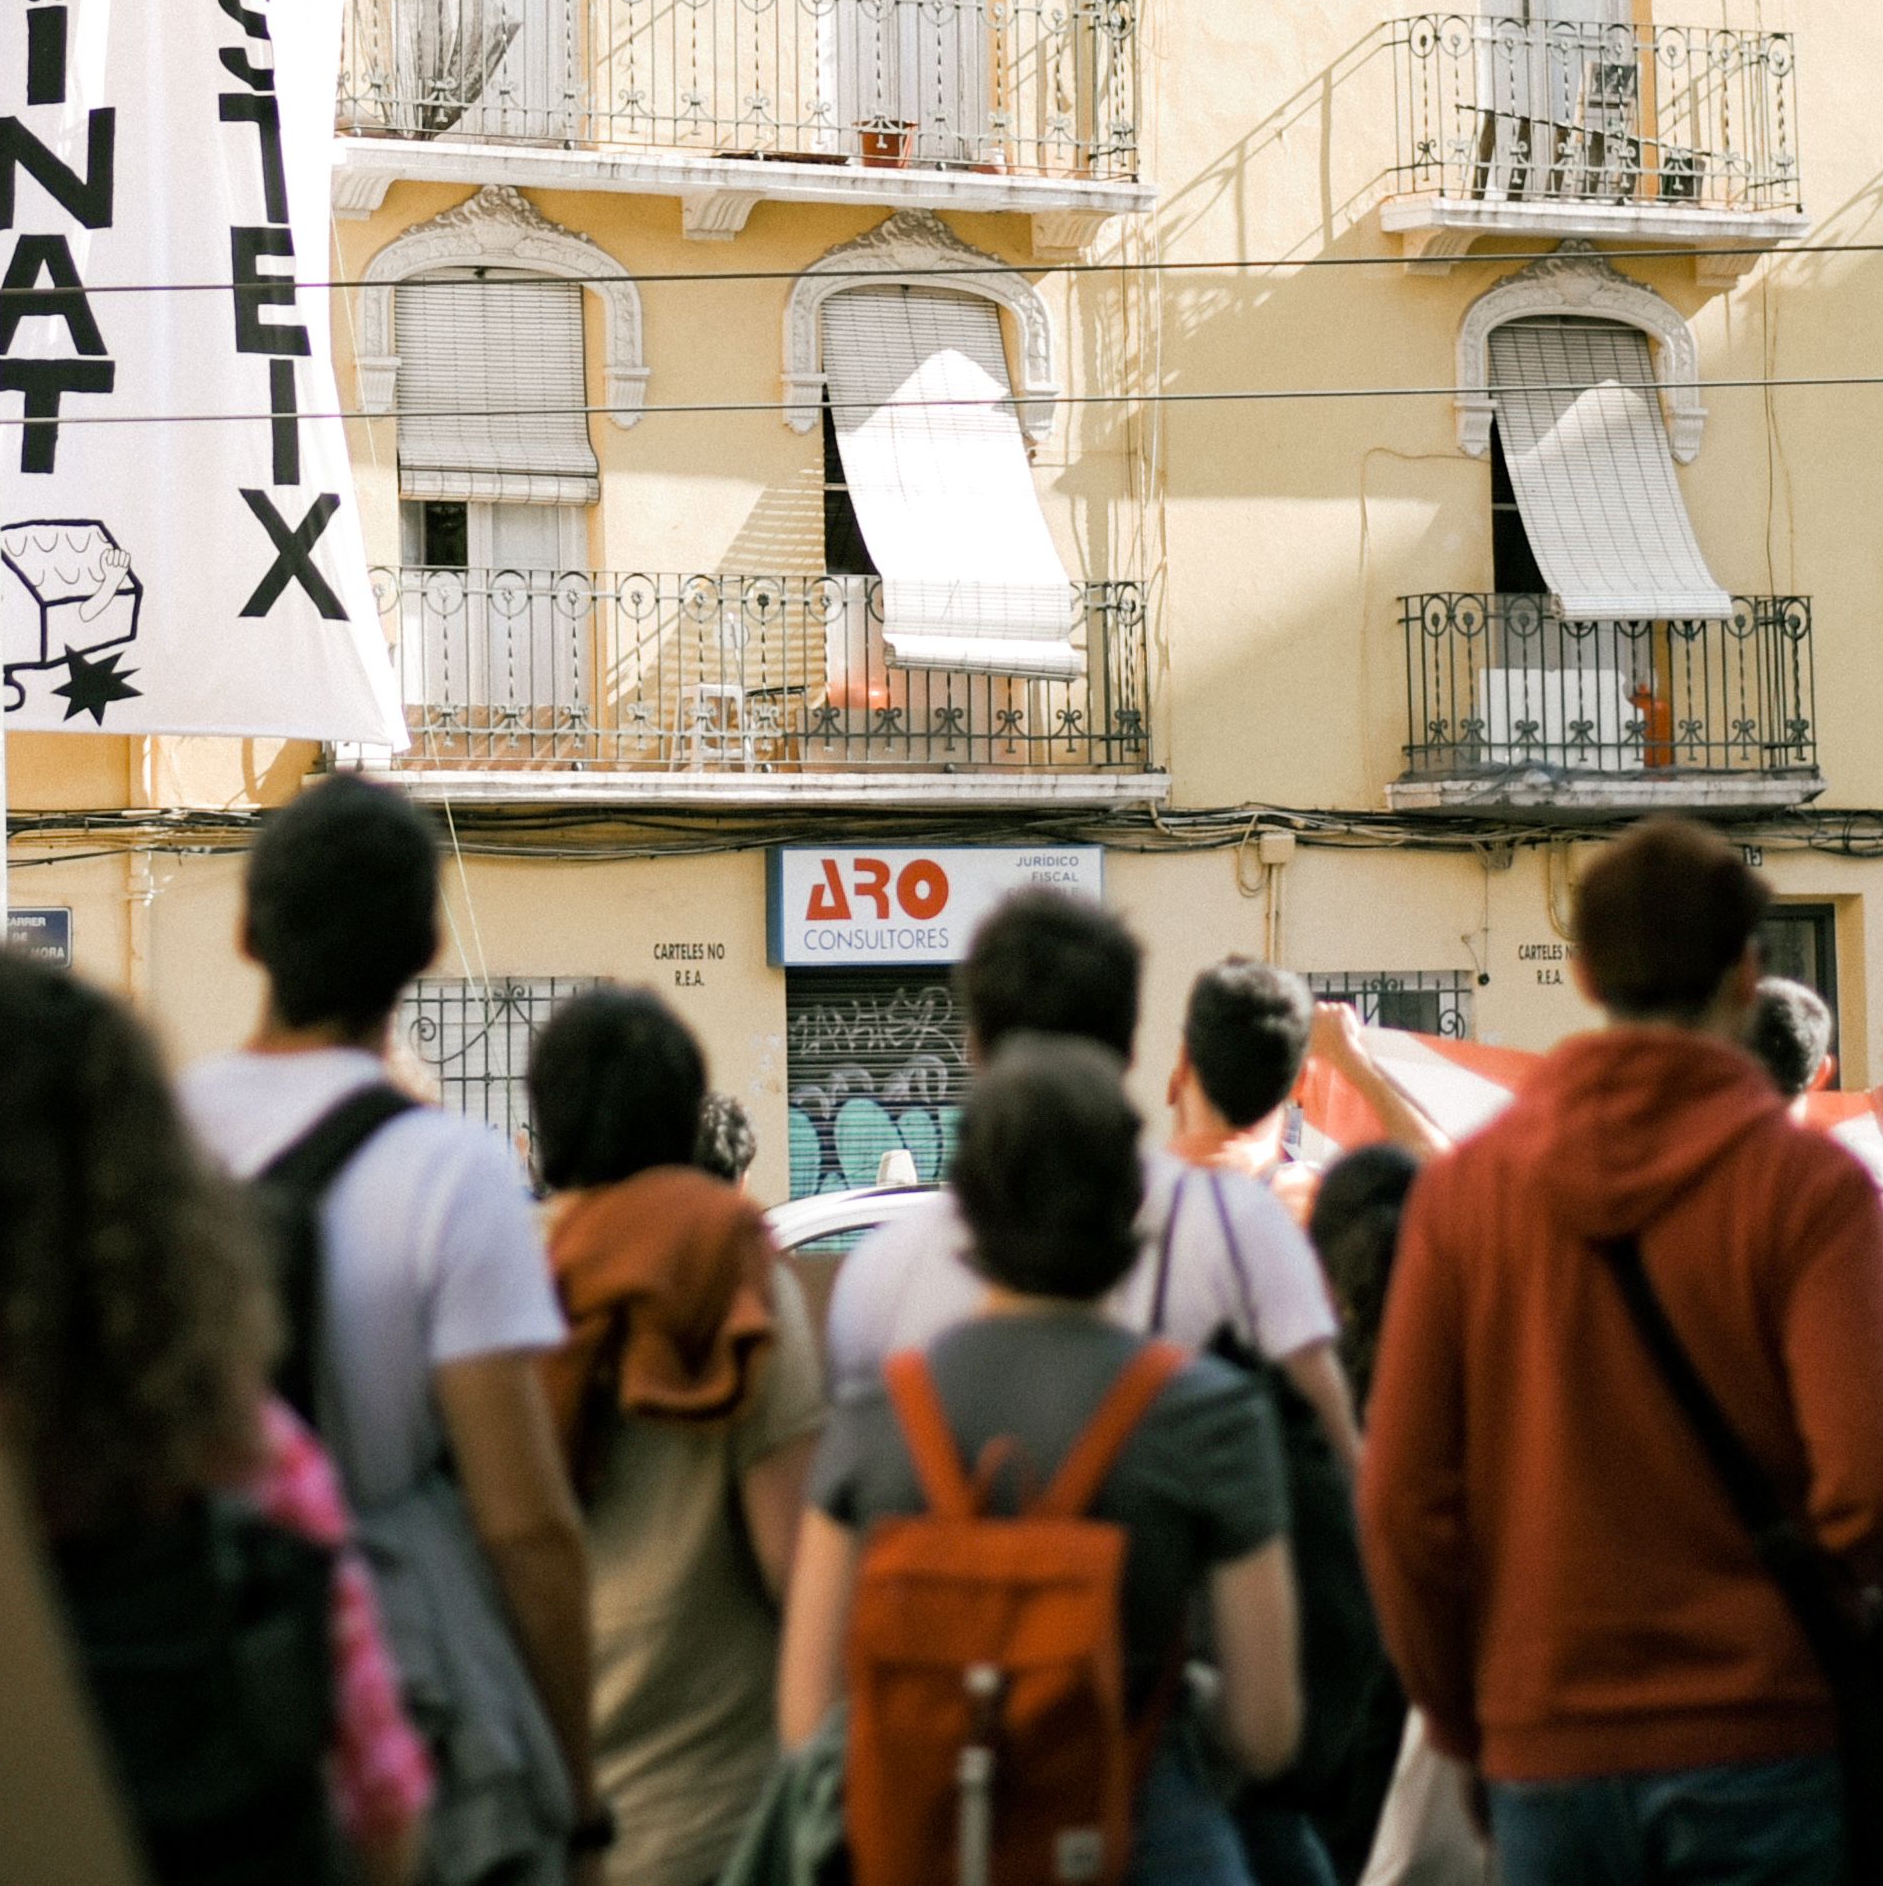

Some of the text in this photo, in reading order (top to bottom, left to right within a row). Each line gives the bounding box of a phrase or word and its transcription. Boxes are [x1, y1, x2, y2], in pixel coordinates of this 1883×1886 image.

[1016, 854, 1079, 868] JURÍDICO
[1031, 871, 1079, 883] FISCAL
[805, 857, 950, 921] ARO
[804, 927, 950, 950] CONSULTORES
[653, 942, 725, 960] CARTELES NO
[1518, 944, 1563, 961] CARTELES
